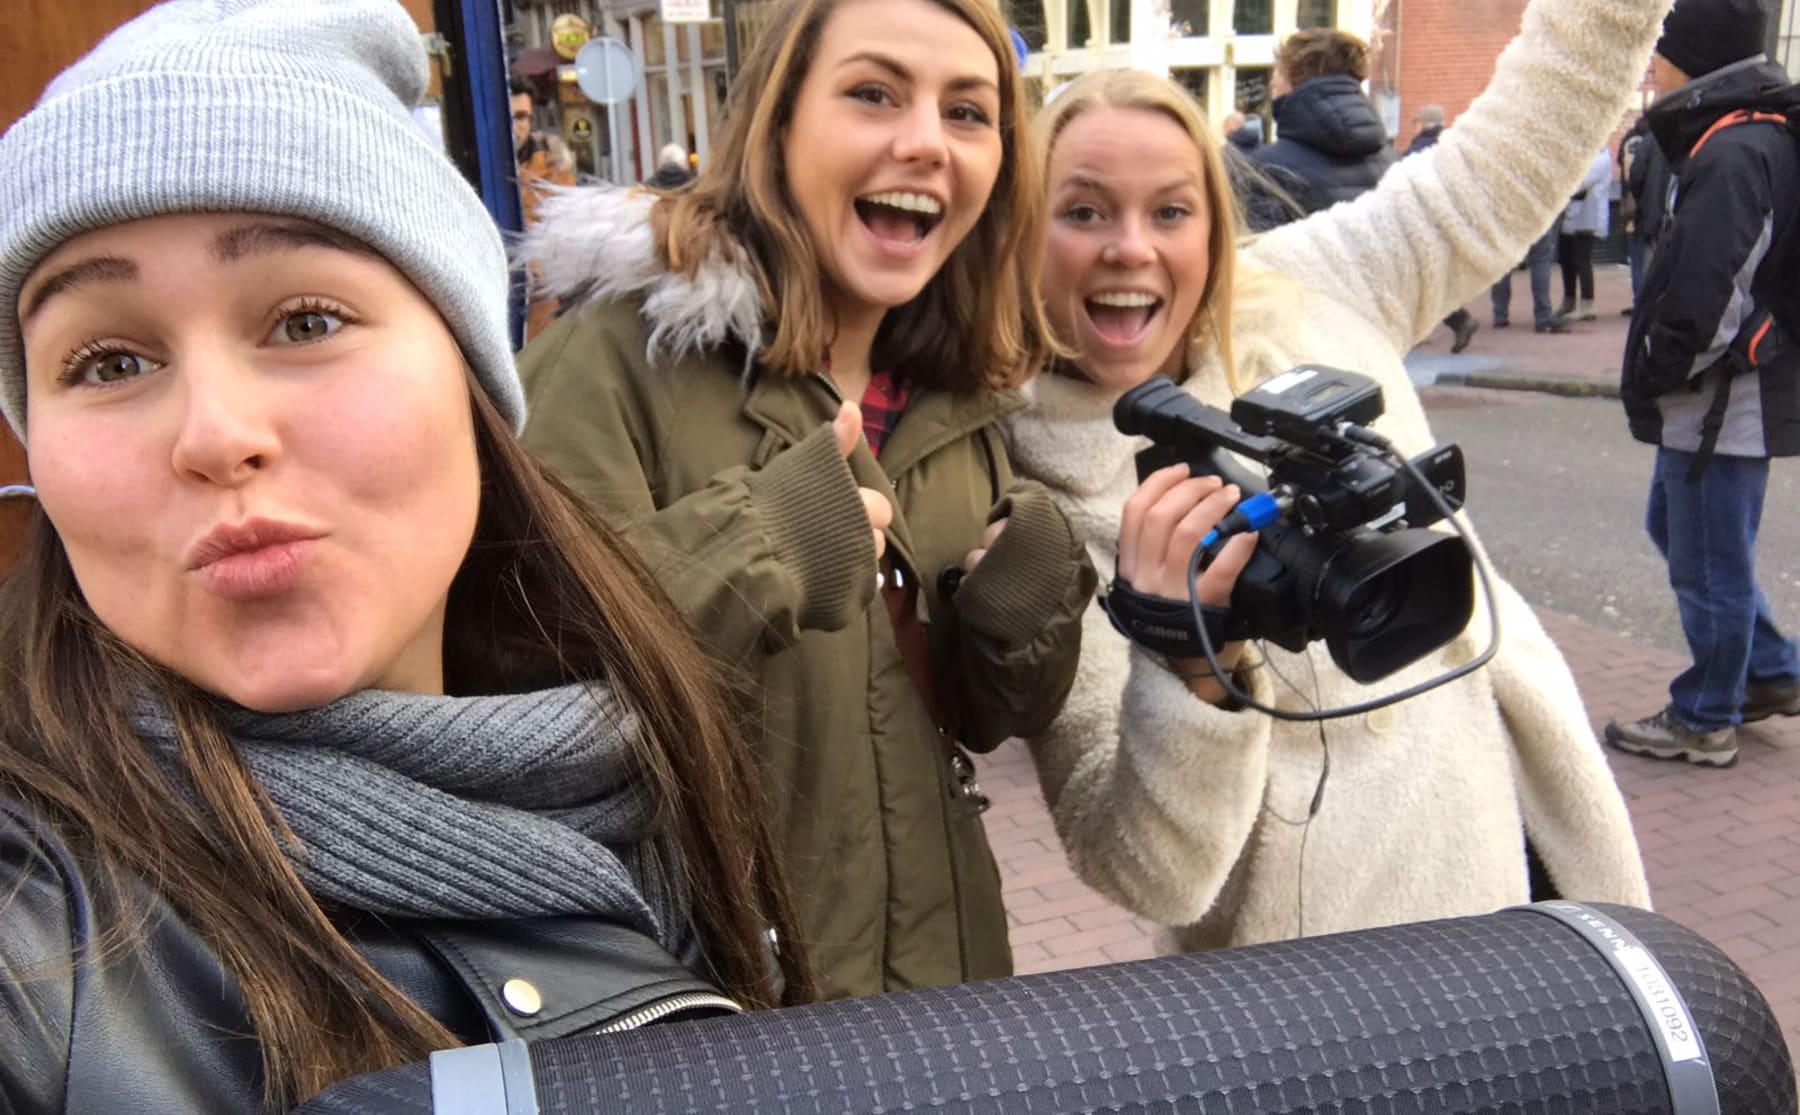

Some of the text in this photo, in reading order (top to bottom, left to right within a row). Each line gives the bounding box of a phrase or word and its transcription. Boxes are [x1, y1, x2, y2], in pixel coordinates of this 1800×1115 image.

[1131, 619, 1188, 641] Canon
[1577, 913, 1629, 951] SENN
[1635, 966, 1689, 1043] 1031092
